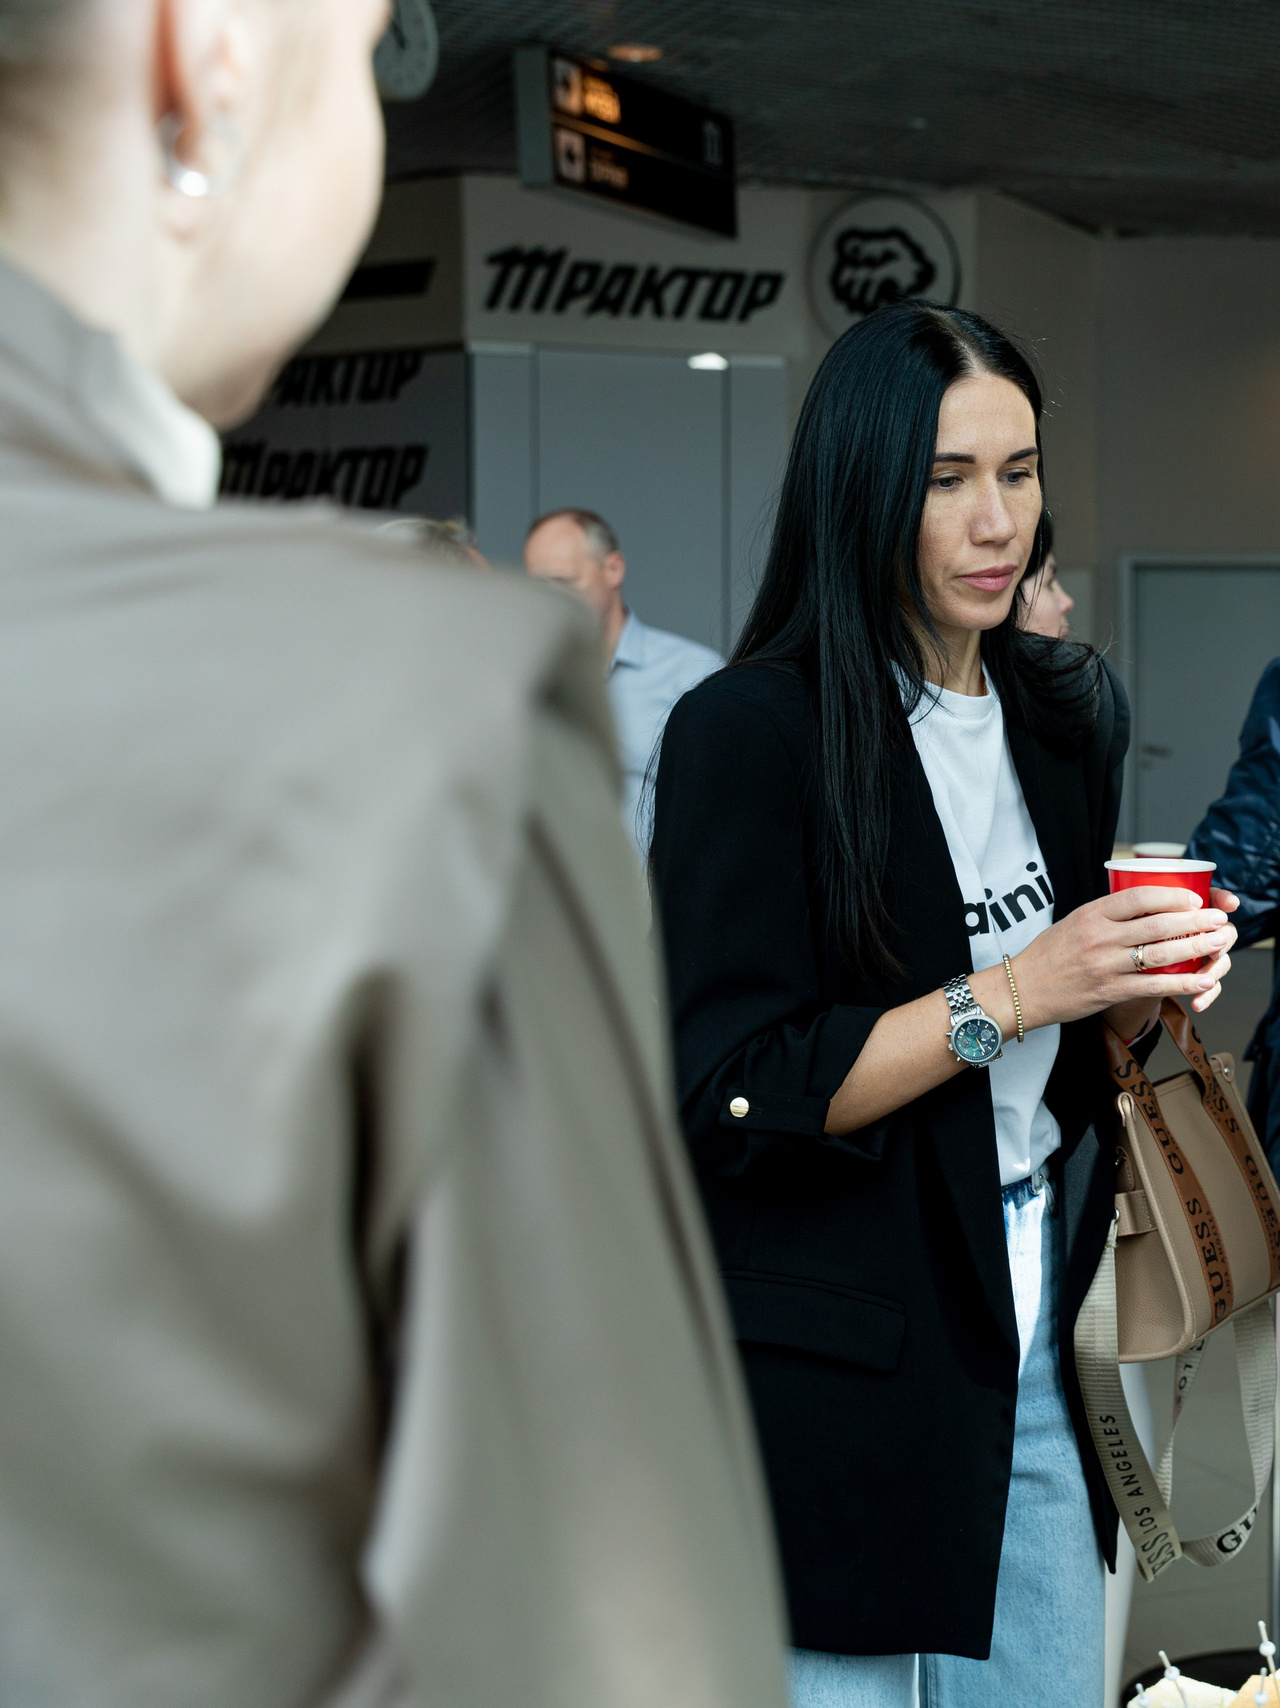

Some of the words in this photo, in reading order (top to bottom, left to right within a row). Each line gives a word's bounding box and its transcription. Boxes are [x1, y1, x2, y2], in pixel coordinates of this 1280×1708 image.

[963, 861, 1055, 937] aini
[1114, 1058, 1184, 1175] GUESS
[1185, 1197, 1227, 1322] GUESS
[1100, 1414, 1145, 1498] ANGELES
[1134, 1506, 1159, 1536] LOS
